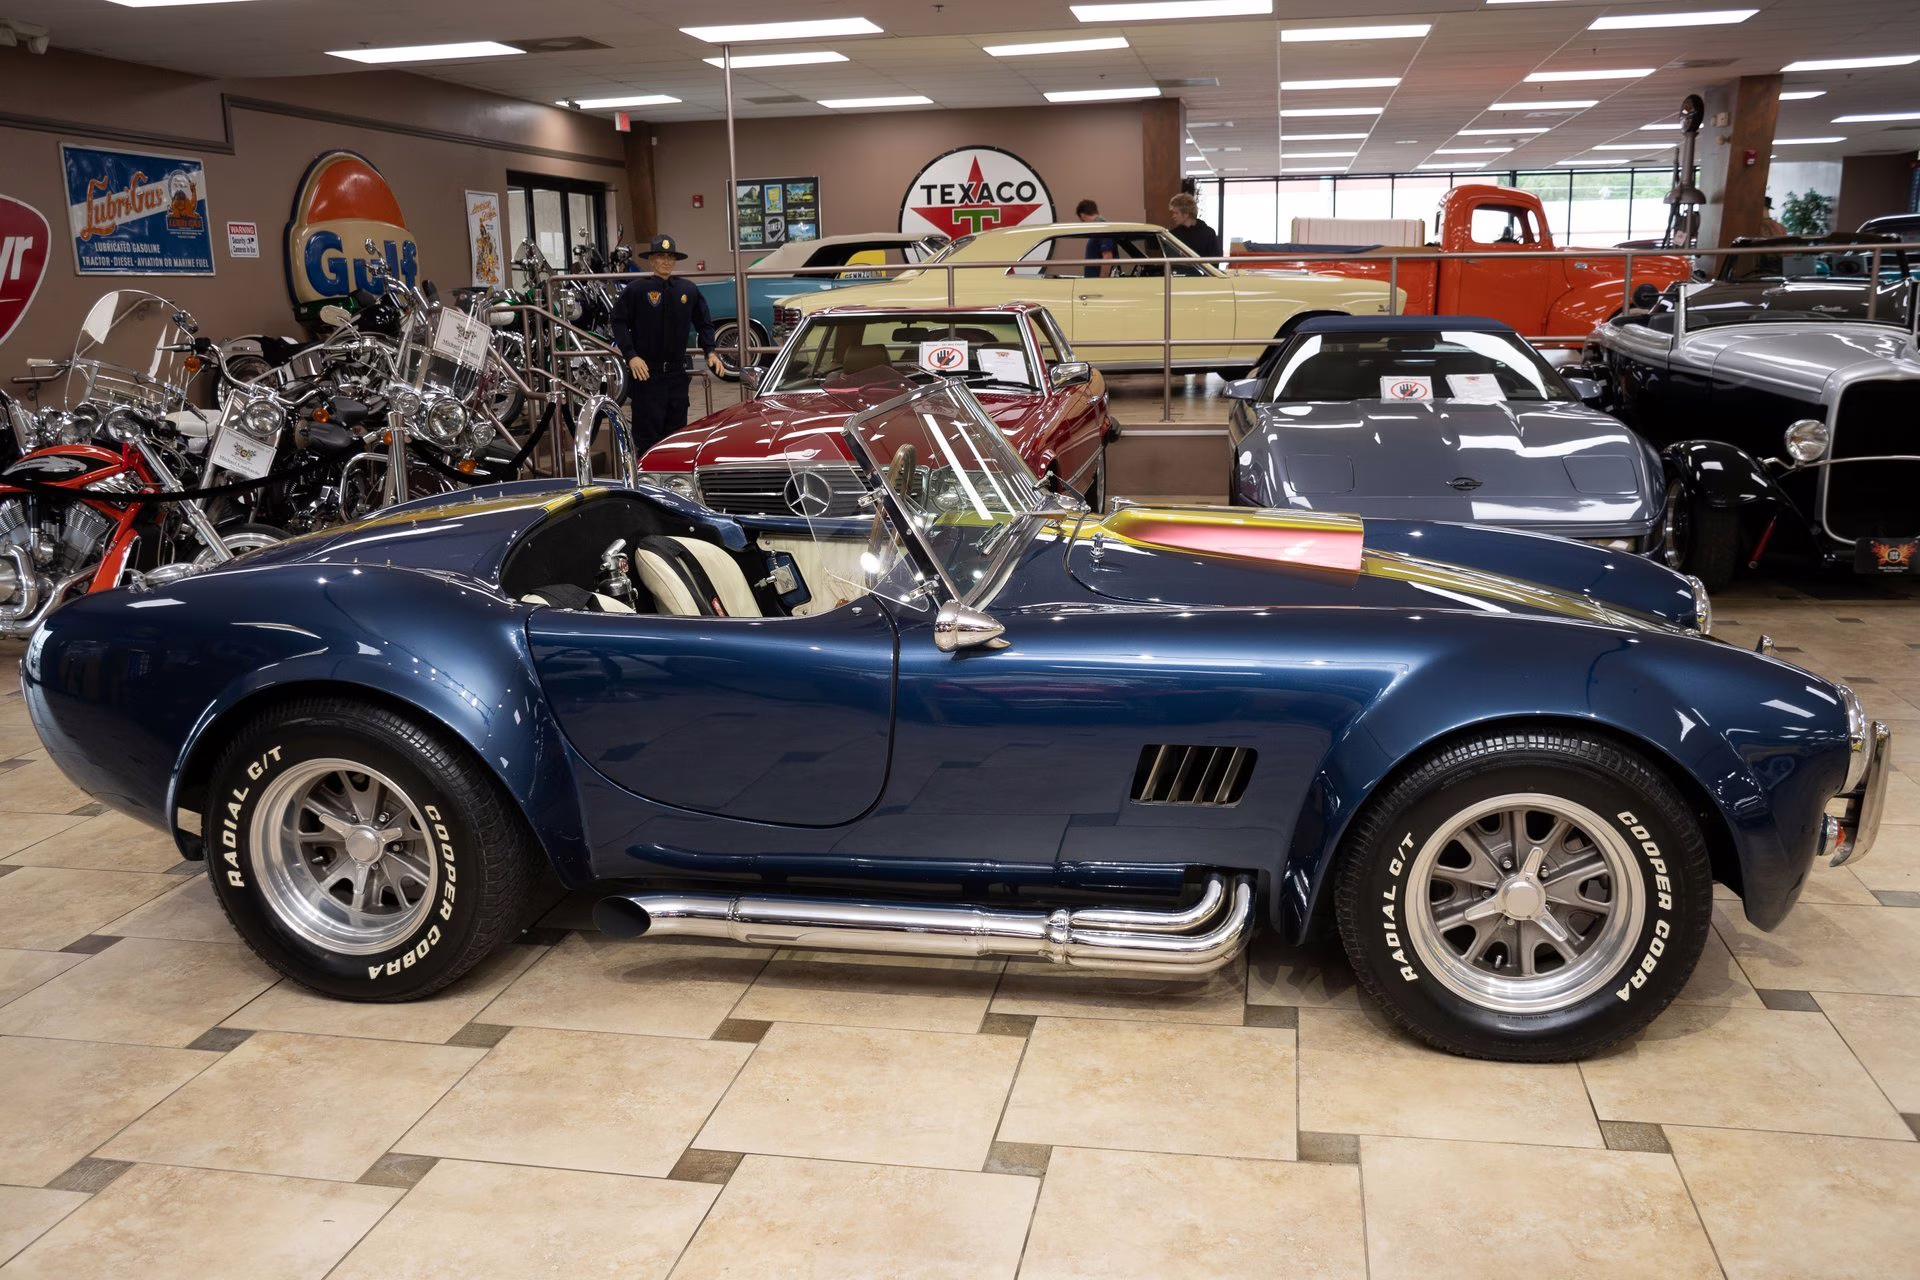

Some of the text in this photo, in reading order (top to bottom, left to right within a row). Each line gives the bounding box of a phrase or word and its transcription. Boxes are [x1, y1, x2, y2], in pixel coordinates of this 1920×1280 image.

[919, 181, 1037, 206] TEXACO
[230, 225, 255, 235] WARNING
[953, 209, 1000, 234] T
[94, 242, 161, 254] LUBRICATED GASOLINE
[232, 237, 246, 245] Security
[82, 256, 209, 268] TRACTOR DIESEL AVIATION OR MARINE FUEL
[305, 231, 417, 297] Gulf
[223, 745, 283, 888] RADIAL G/T
[368, 804, 457, 980] COOPER COBRA
[1382, 832, 1419, 982] RADIAL G/T
[1615, 811, 1673, 1002] COOPER COBRA
